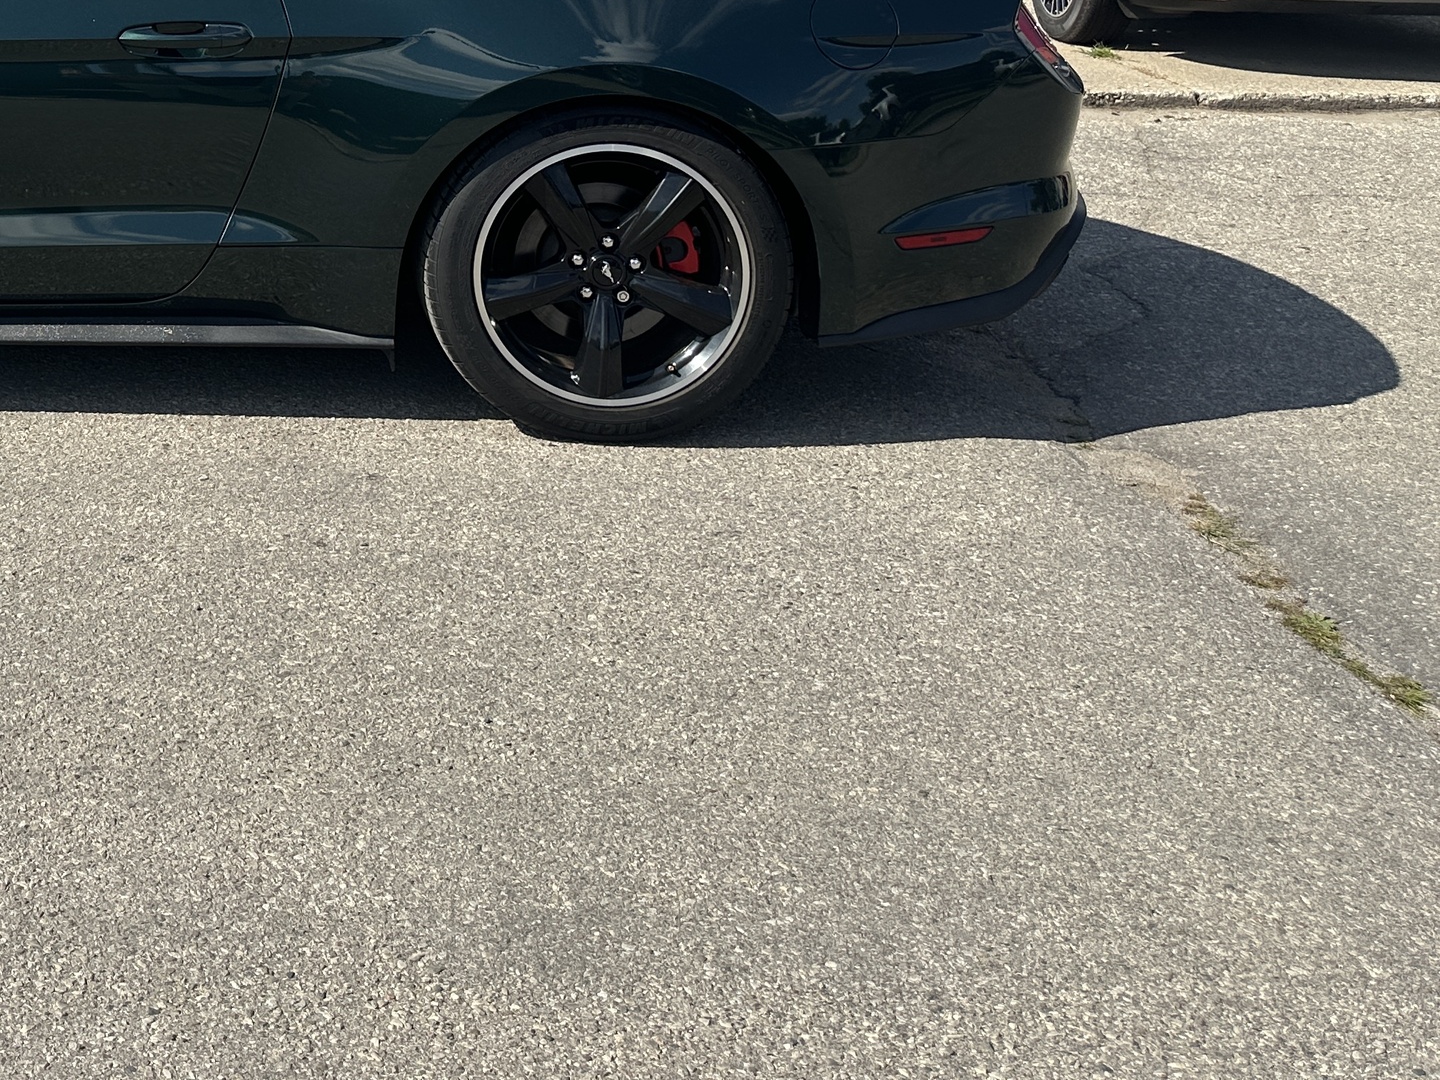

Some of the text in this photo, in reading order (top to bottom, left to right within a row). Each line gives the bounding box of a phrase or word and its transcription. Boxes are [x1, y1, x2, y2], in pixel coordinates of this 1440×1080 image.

[705, 147, 734, 173] PILOT
[734, 172, 761, 205] SPORT
[527, 402, 648, 435] MICHELIN
